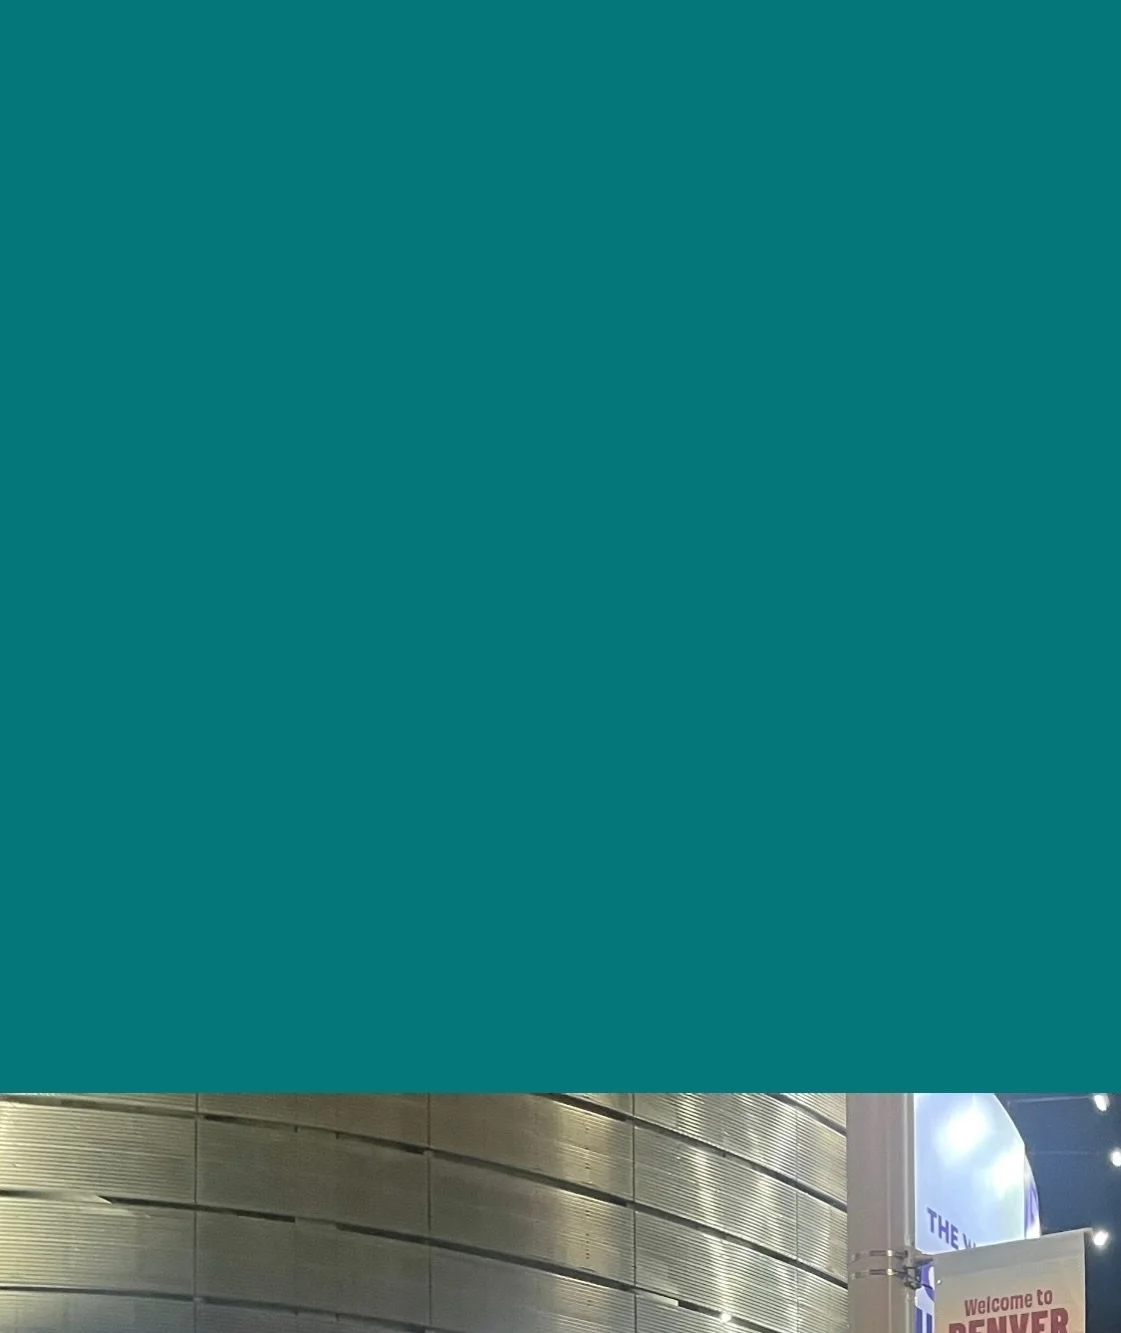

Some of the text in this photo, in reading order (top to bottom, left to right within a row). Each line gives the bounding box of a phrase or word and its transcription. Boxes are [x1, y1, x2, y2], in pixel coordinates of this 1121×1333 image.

[926, 1207, 960, 1250] THE
[964, 1289, 1053, 1317] Welcome to
